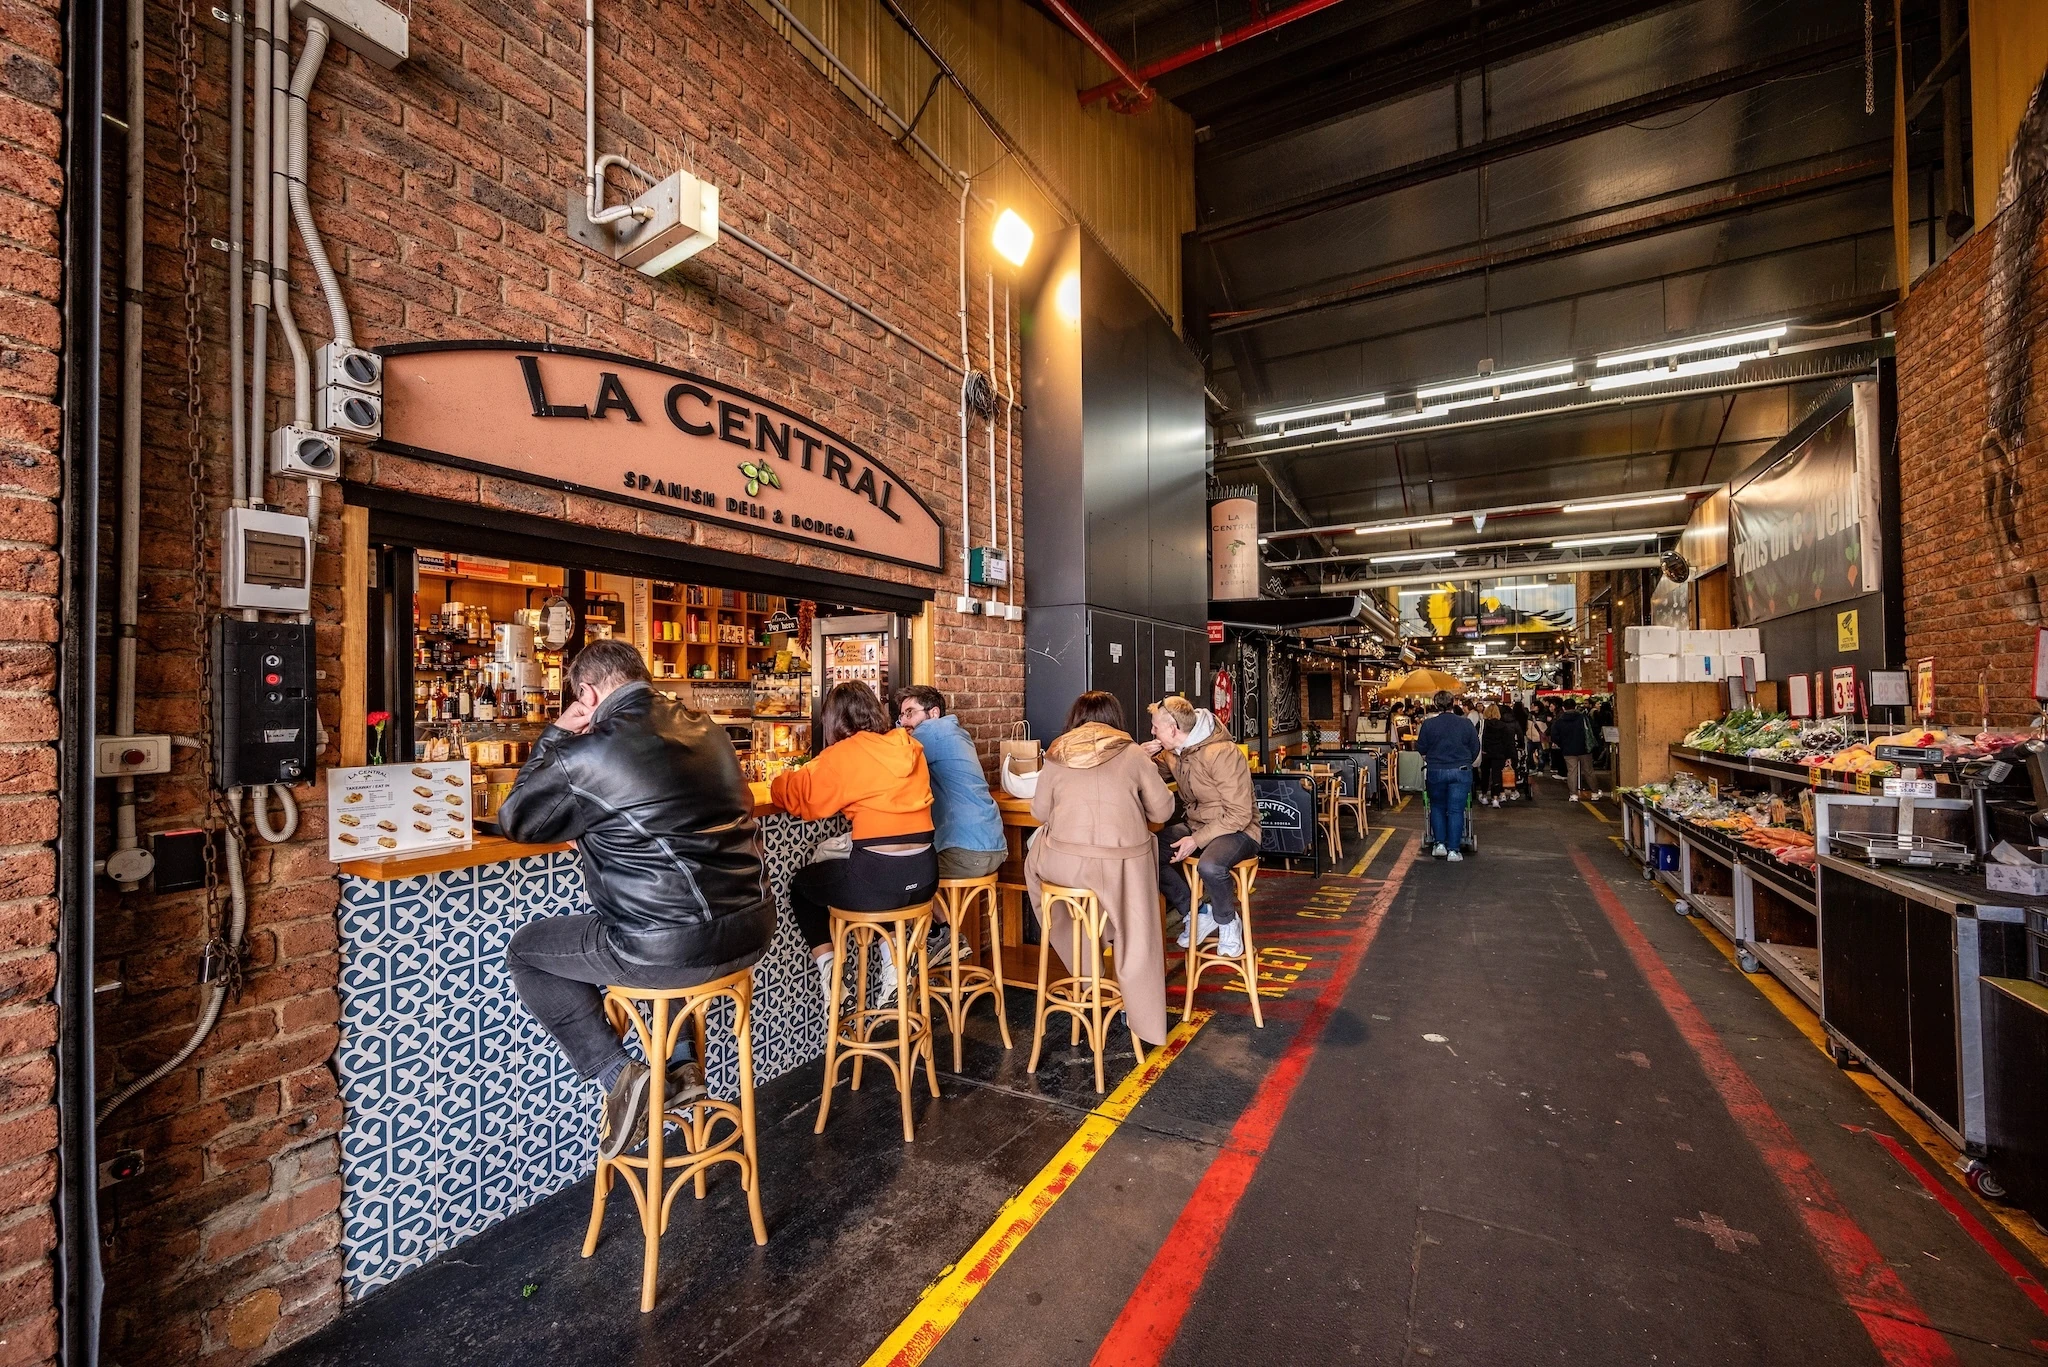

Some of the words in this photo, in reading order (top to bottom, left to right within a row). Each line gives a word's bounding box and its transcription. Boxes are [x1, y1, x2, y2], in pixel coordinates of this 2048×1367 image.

[515, 355, 642, 422] LA
[664, 384, 901, 523] CENTRAL
[624, 471, 715, 507] SPANISH
[725, 497, 765, 520] DELI
[772, 510, 784, 524] &
[791, 514, 855, 542] BODEGA
[1212, 523, 1256, 532] CENTRAL
[1771, 518, 1790, 562] on
[781, 621, 795, 629] here
[358, 770, 387, 778] CENTRAL
[1257, 801, 1296, 820] ENTRAL
[1223, 947, 1313, 998] KEEP
